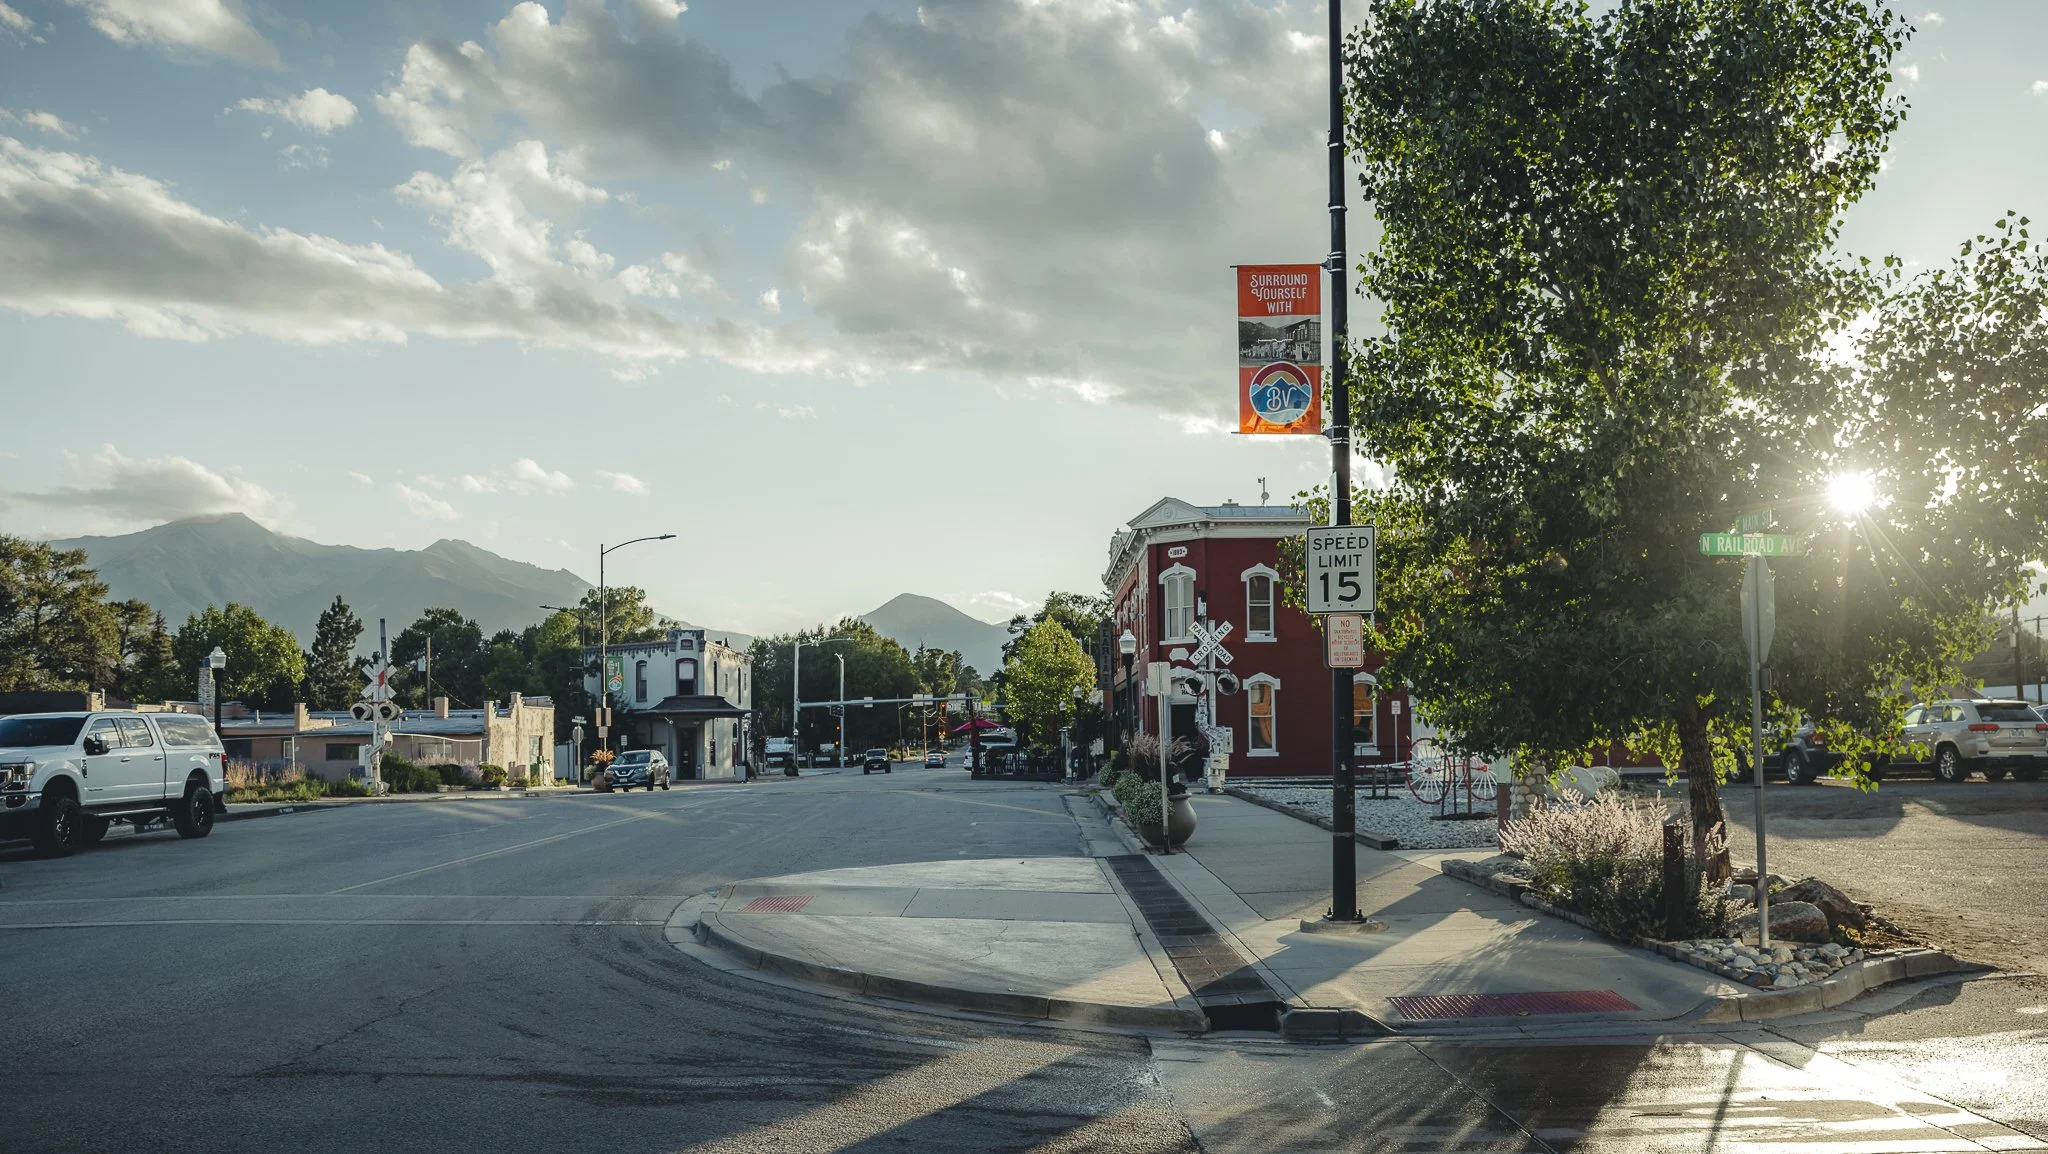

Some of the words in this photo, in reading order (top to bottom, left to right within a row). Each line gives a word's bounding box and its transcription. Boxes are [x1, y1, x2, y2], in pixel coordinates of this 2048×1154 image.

[1250, 273, 1308, 288] SURROUND
[1250, 287, 1307, 301] YOURSELF
[1266, 301, 1292, 313] WITH
[1266, 386, 1297, 411] BV
[1312, 536, 1369, 551] SPEED
[1702, 536, 1710, 552] N
[1717, 537, 1774, 553] RAILROAD
[1780, 537, 1803, 553] AVE
[1318, 554, 1362, 568] LIMIT
[1319, 571, 1361, 603] 15
[1340, 619, 1350, 628] NO
[1191, 624, 1207, 641] RAIL
[1213, 645, 1231, 662] ROAD
[1193, 624, 1230, 661] CROSSING
